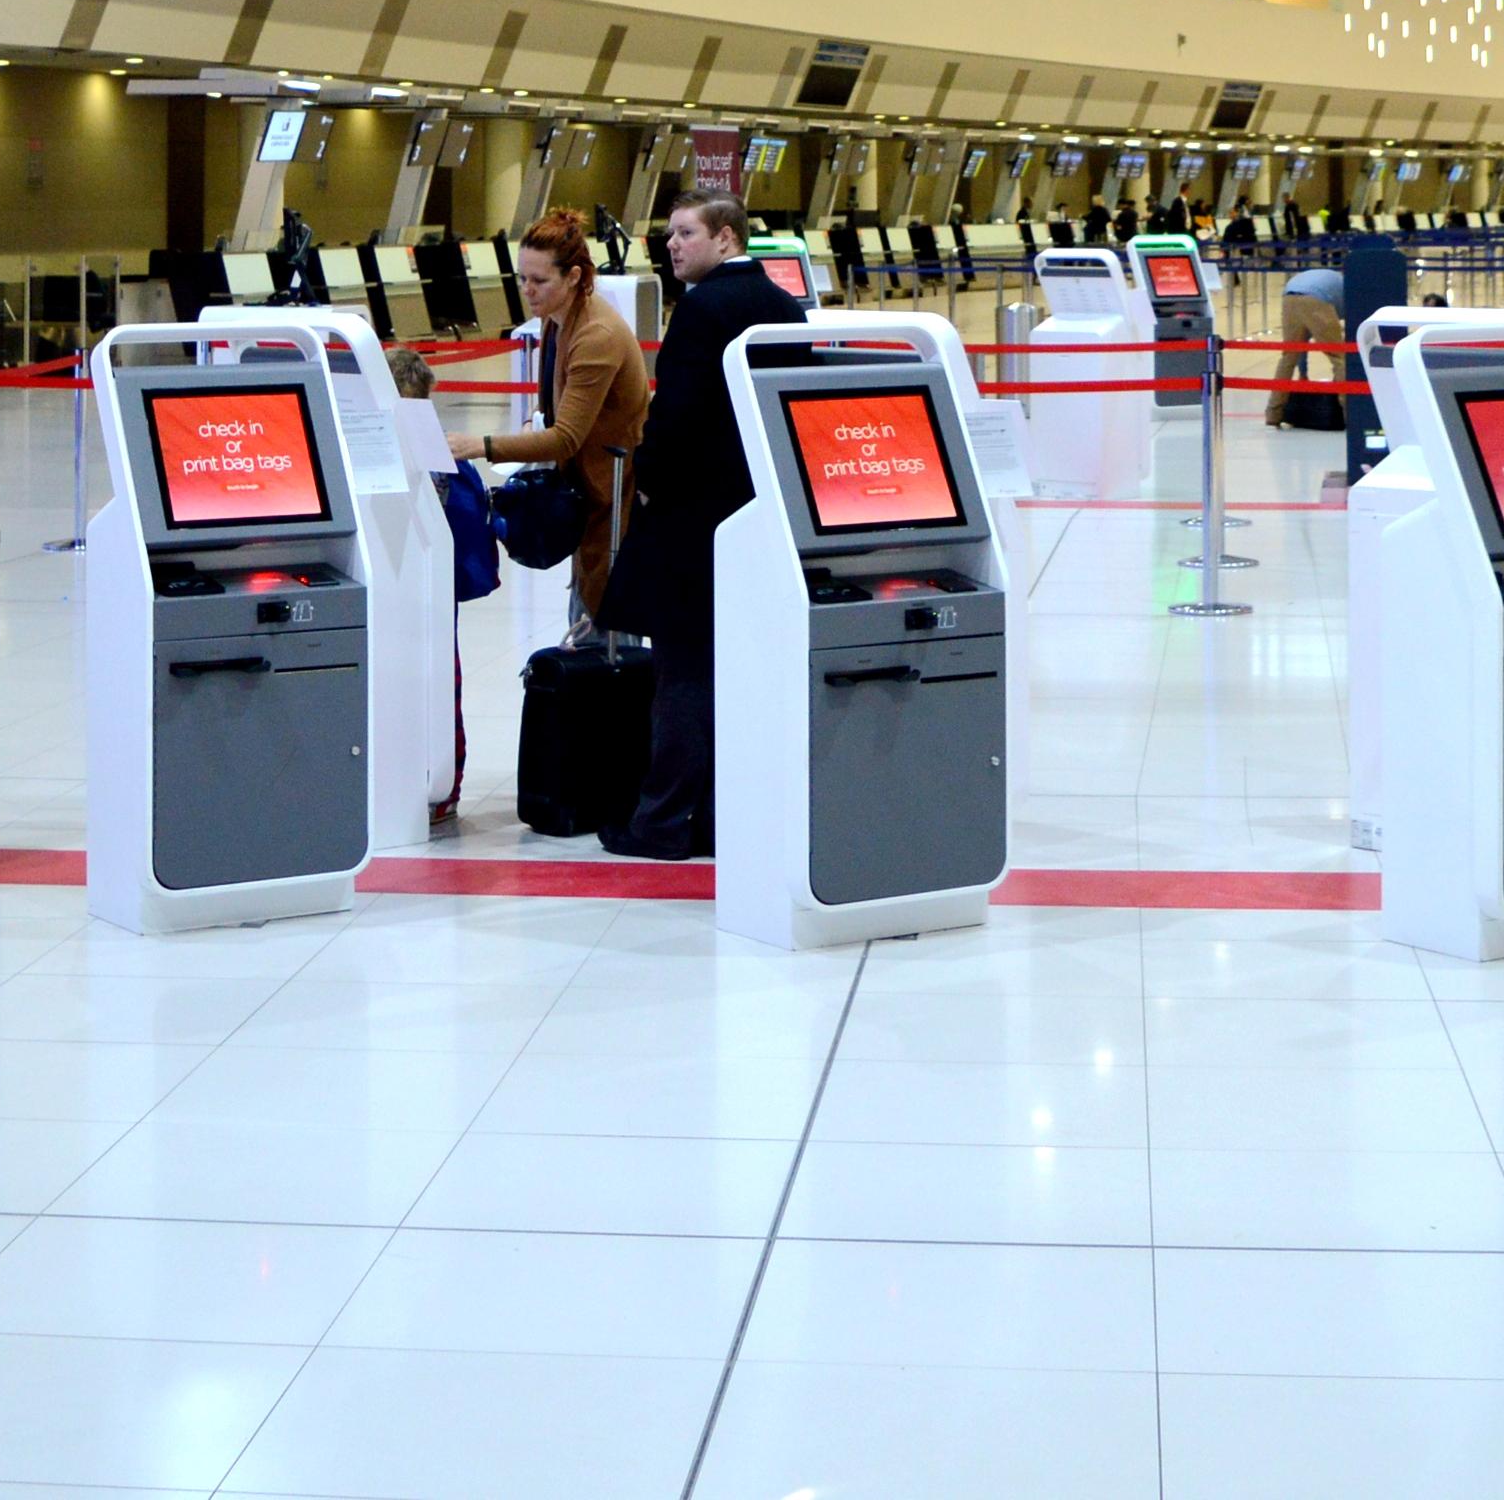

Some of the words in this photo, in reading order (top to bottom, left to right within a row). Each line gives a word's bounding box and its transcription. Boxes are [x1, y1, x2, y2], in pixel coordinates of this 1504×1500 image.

[198, 421, 246, 437] check
[249, 420, 263, 435] in
[834, 423, 880, 440] check
[882, 422, 895, 437] in
[225, 440, 242, 453] or
[861, 442, 877, 455] or
[183, 455, 219, 474] print
[222, 455, 253, 473] bag
[258, 454, 292, 470] tags
[824, 459, 858, 478] print
[859, 458, 890, 476] bag
[892, 456, 925, 474] tags
